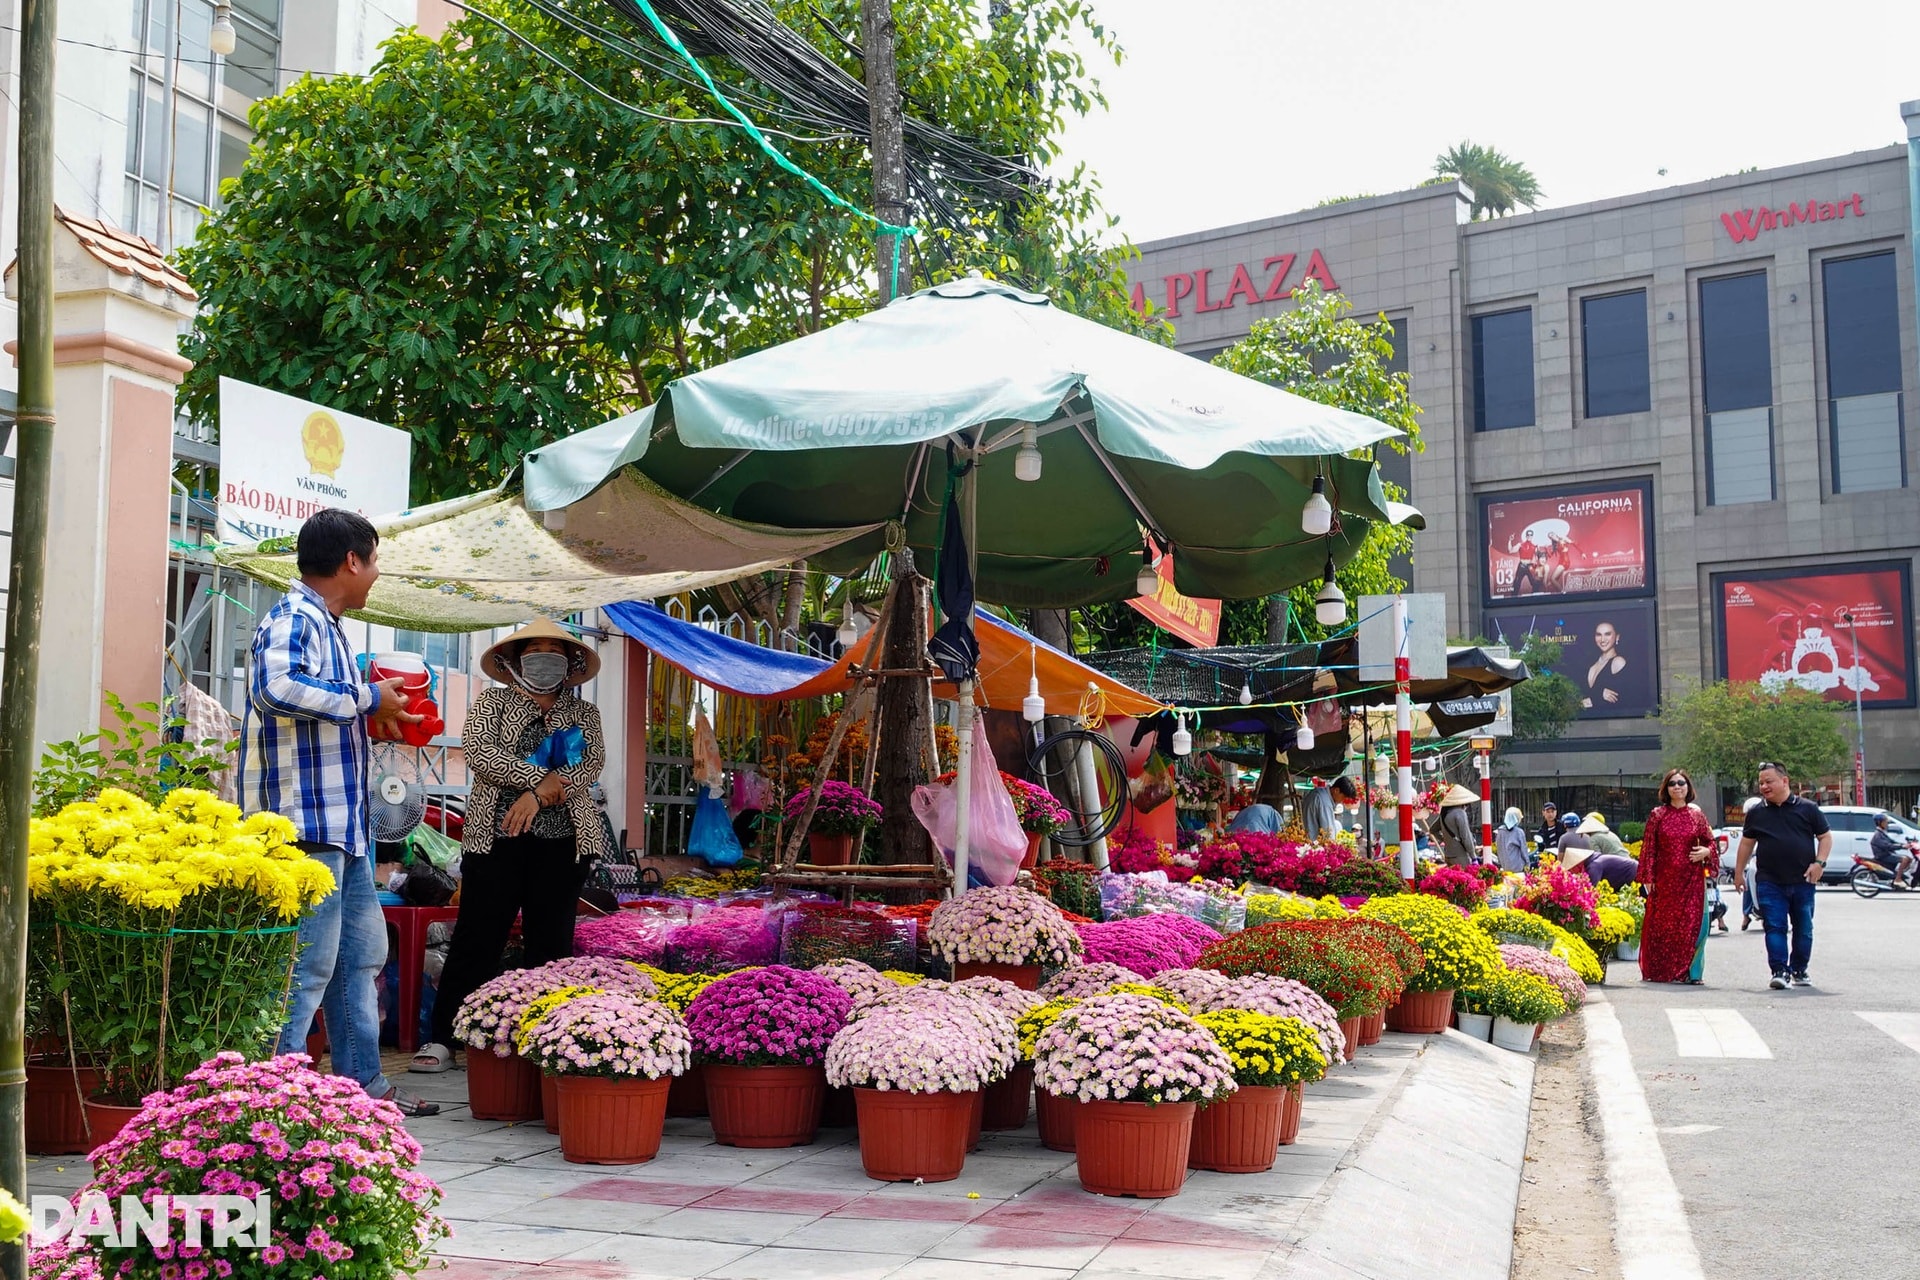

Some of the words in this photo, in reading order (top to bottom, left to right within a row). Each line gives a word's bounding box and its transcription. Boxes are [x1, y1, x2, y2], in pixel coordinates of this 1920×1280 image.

[1720, 192, 1865, 243] WinMart
[1163, 248, 1340, 318] PLAZA
[296, 477, 315, 491] VĂN
[317, 482, 347, 499] PHÒNG
[226, 481, 260, 509] BÁO
[264, 491, 291, 520] ĐẠI
[1558, 496, 1632, 513] CALIFORNIA
[1558, 509, 1595, 517] FITNESS
[1496, 569, 1514, 585] 03
